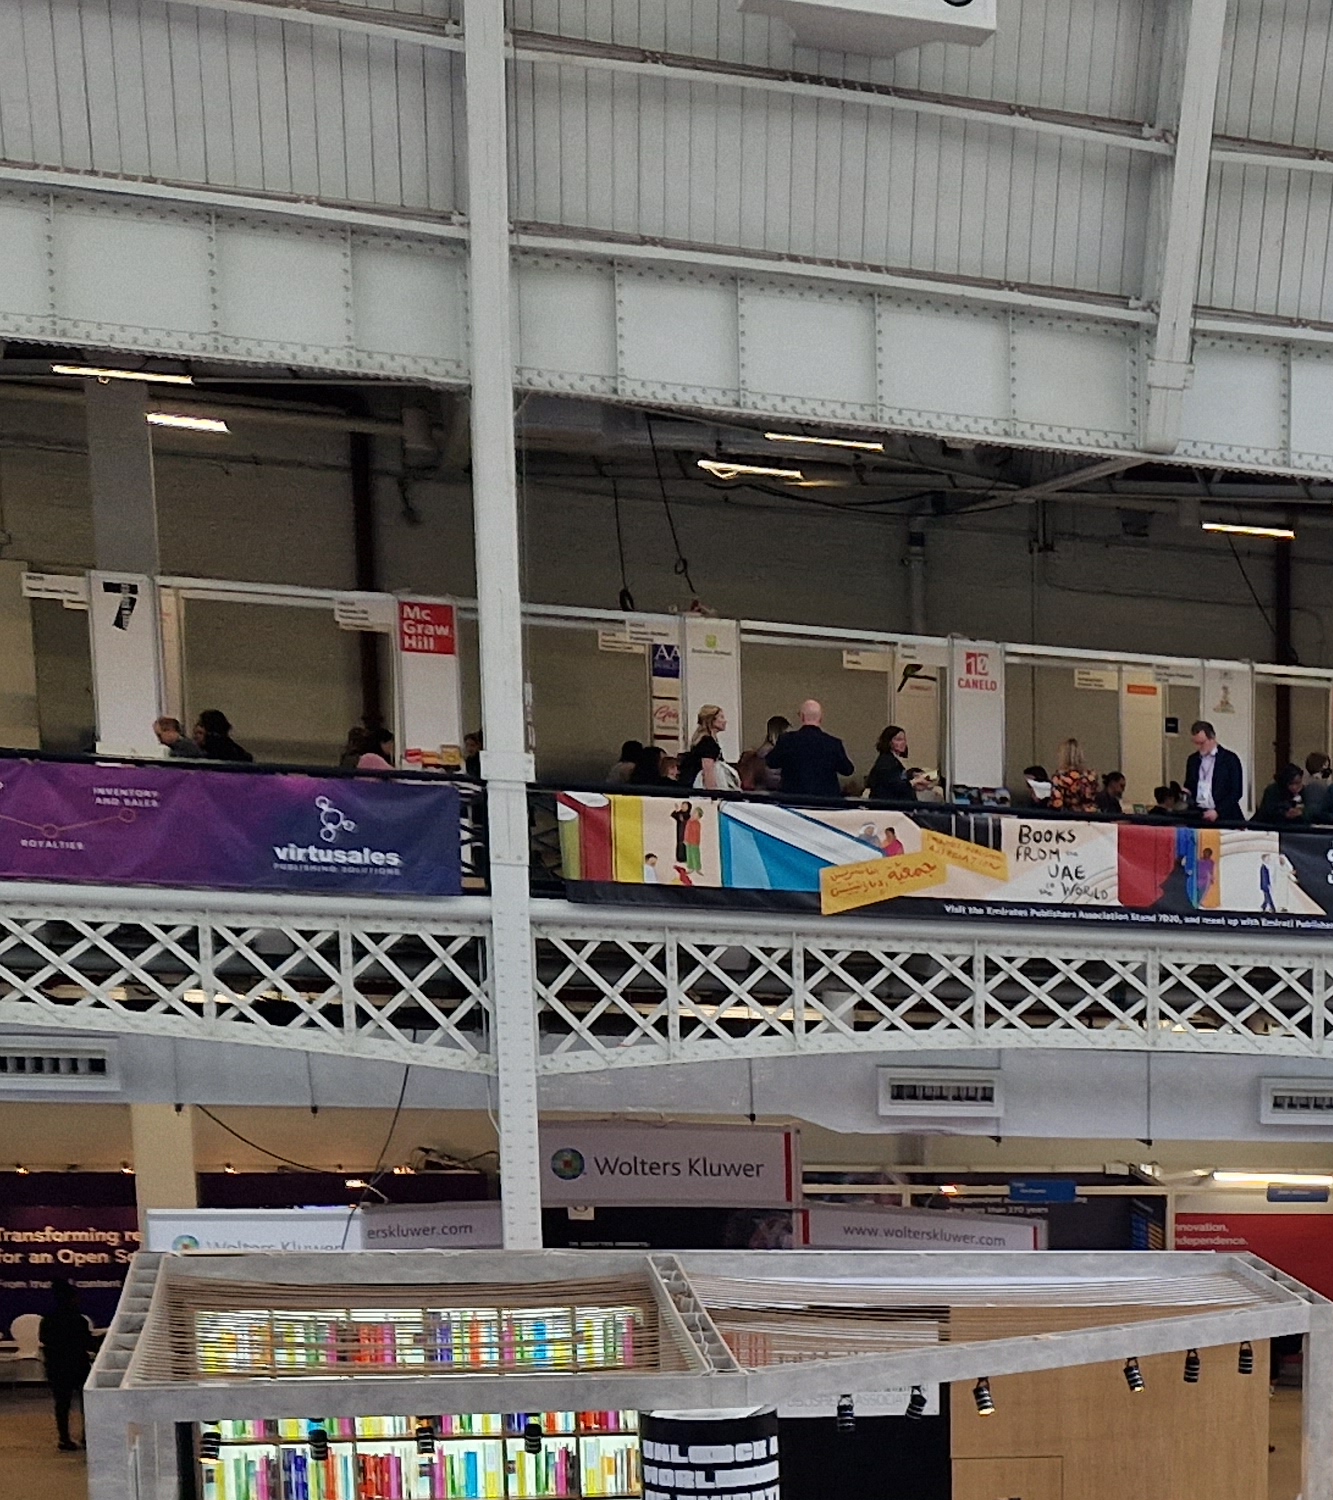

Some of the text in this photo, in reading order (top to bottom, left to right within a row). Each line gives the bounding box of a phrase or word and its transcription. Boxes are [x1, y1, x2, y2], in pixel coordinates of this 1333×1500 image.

[403, 604, 431, 620] Mc
[403, 621, 449, 636] Graw
[404, 635, 435, 650] Hill
[957, 677, 998, 692] CANELO
[93, 787, 160, 798] INVENTORY
[95, 797, 160, 808] AND SALES
[1017, 824, 1076, 845] BOOKS
[20, 838, 84, 850] ROYALTIES
[273, 843, 402, 866] virtusales
[1015, 846, 1061, 862] FROM
[273, 863, 338, 873] PUBLISHING
[1049, 865, 1086, 881] UAE
[1060, 883, 1109, 901] WORLD
[945, 905, 966, 915] Visit
[969, 906, 984, 915] the
[987, 906, 1028, 918] Emirates
[1030, 908, 1077, 919] Publishers
[1078, 910, 1129, 921] Association
[1131, 912, 1157, 922] Stand
[1184, 915, 1200, 925] and
[1240, 917, 1260, 927] with
[1261, 918, 1294, 929] Emirati
[594, 1154, 765, 1180] Wolters Kluwer
[367, 1220, 473, 1241] erskluwer.com
[842, 1223, 1006, 1247] www.wolterskluwer.com
[1175, 1222, 1229, 1233] nnovation,
[1175, 1235, 1249, 1247] ndependence.
[28, 1253, 54, 1265] an
[57, 1249, 109, 1268] Open
